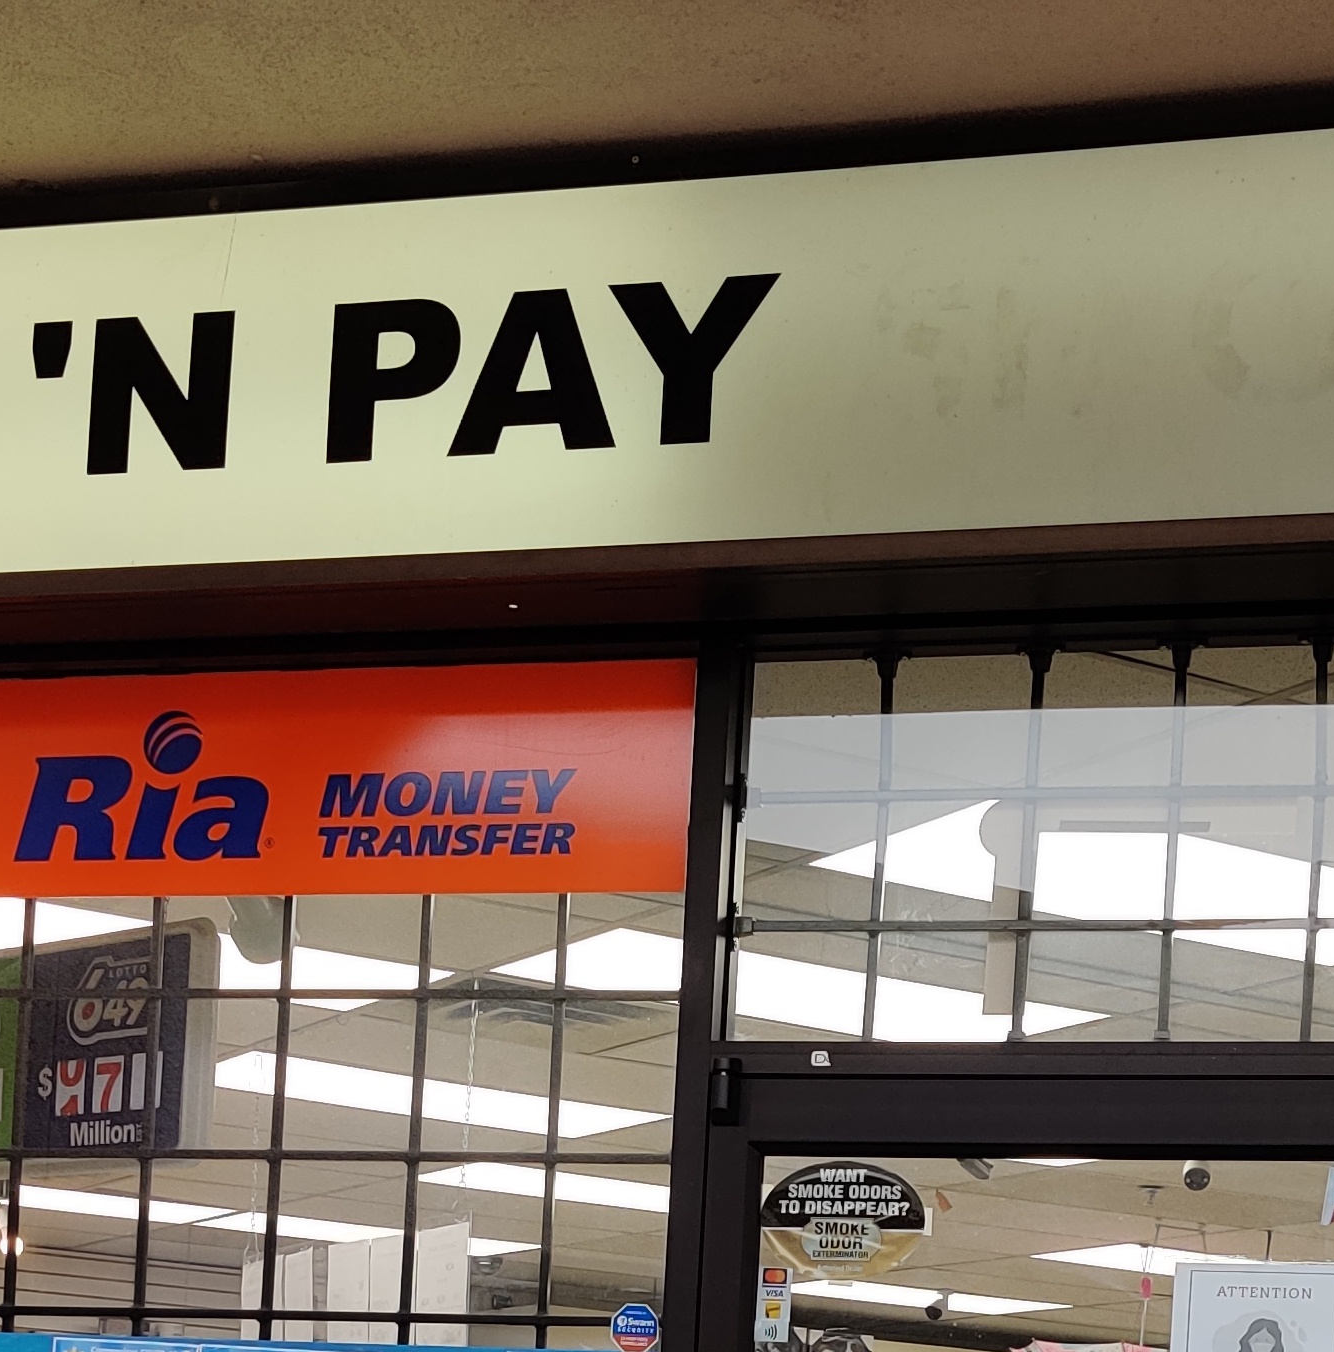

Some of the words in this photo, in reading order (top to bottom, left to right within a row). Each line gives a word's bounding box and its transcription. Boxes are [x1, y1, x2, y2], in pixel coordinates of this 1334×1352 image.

[33, 311, 235, 475] 'N
[326, 273, 782, 464] PAY
[14, 710, 269, 861] Ria
[319, 769, 577, 818] MONEY
[321, 824, 576, 858] TRANSFER
[108, 963, 148, 979] LOTTO
[69, 1121, 136, 1147] Million
[819, 1169, 867, 1183] WANT
[788, 1184, 844, 1199] SMOKE
[848, 1185, 902, 1199] ODORS
[779, 1200, 800, 1214] TO
[805, 1201, 910, 1216] DISAPPEAR?
[814, 1222, 869, 1236] SMOKE
[819, 1237, 863, 1249] ODOR
[1216, 1286, 1312, 1299] ATTENTION
